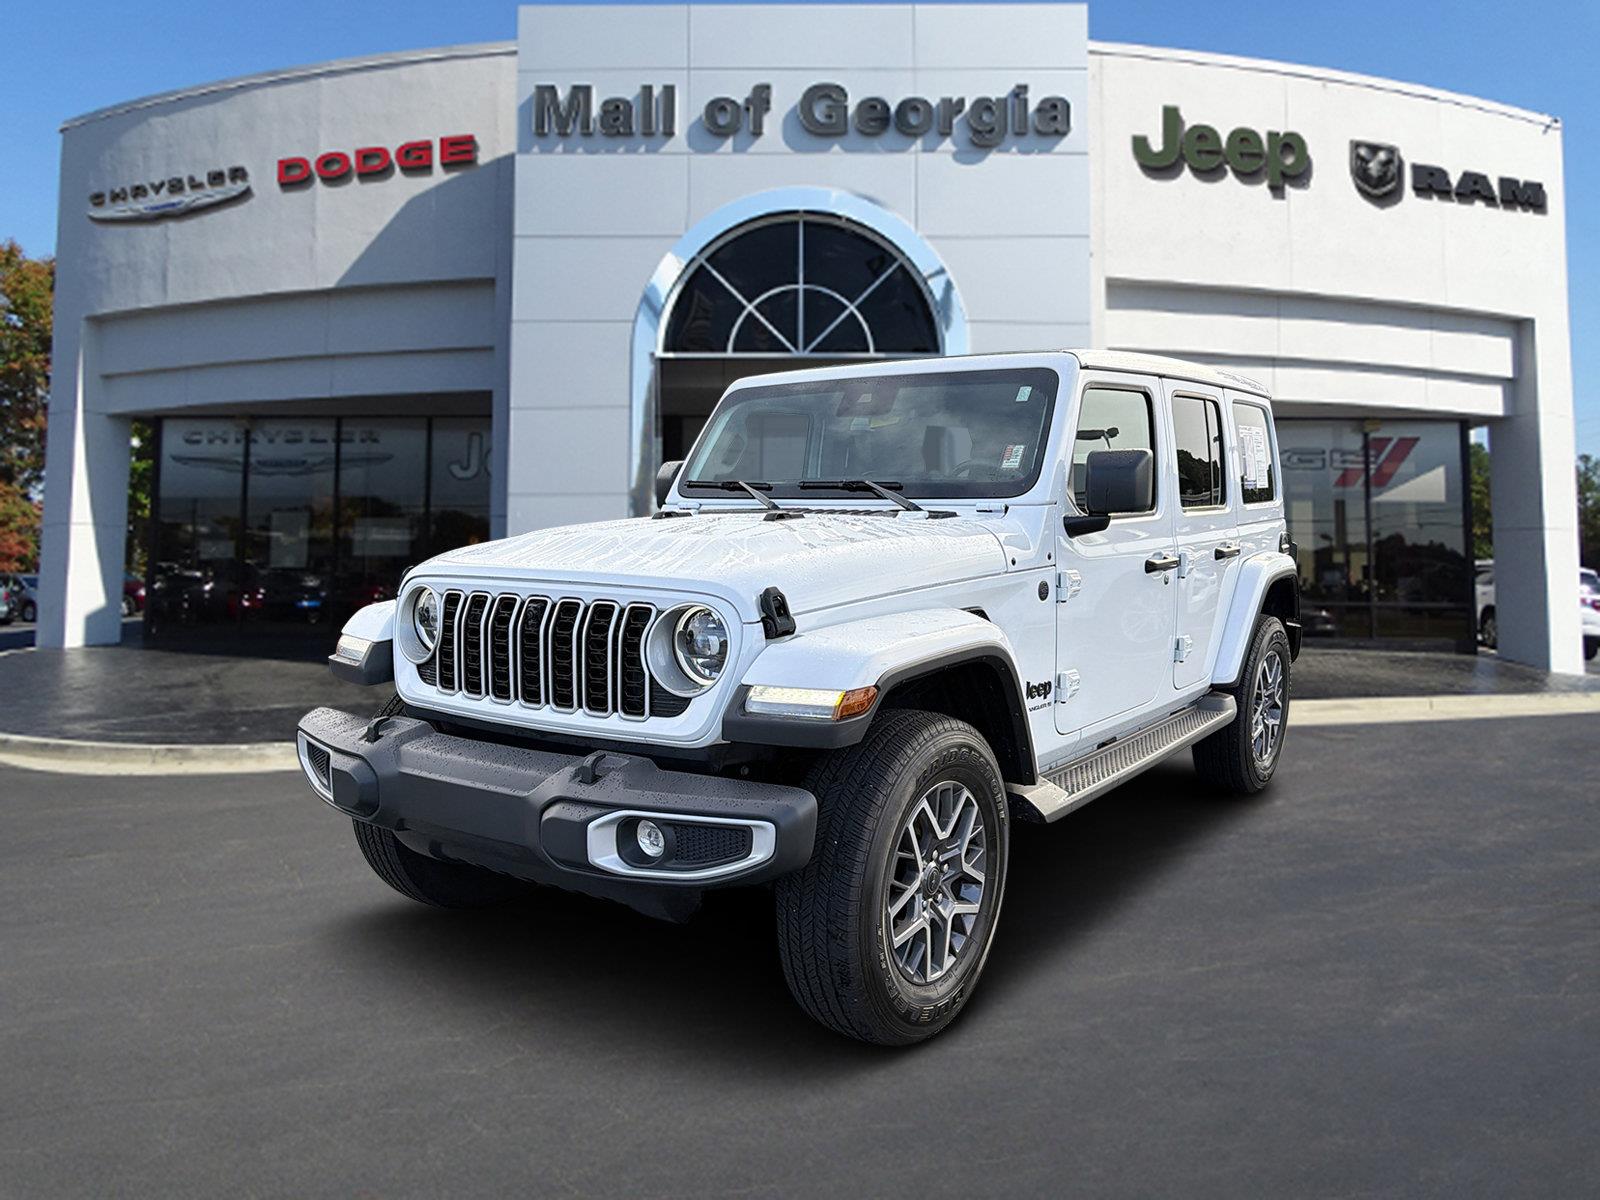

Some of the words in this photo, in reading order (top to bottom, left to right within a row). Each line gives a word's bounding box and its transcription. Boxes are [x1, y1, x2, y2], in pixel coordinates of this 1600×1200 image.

[534, 84, 675, 136] Mall
[703, 84, 771, 136] of
[798, 83, 1071, 147] Georgia
[277, 134, 477, 185] DODGE
[1132, 105, 1308, 187] Jeep
[89, 166, 250, 206] CHRYSLER
[1410, 163, 1546, 210] RAM
